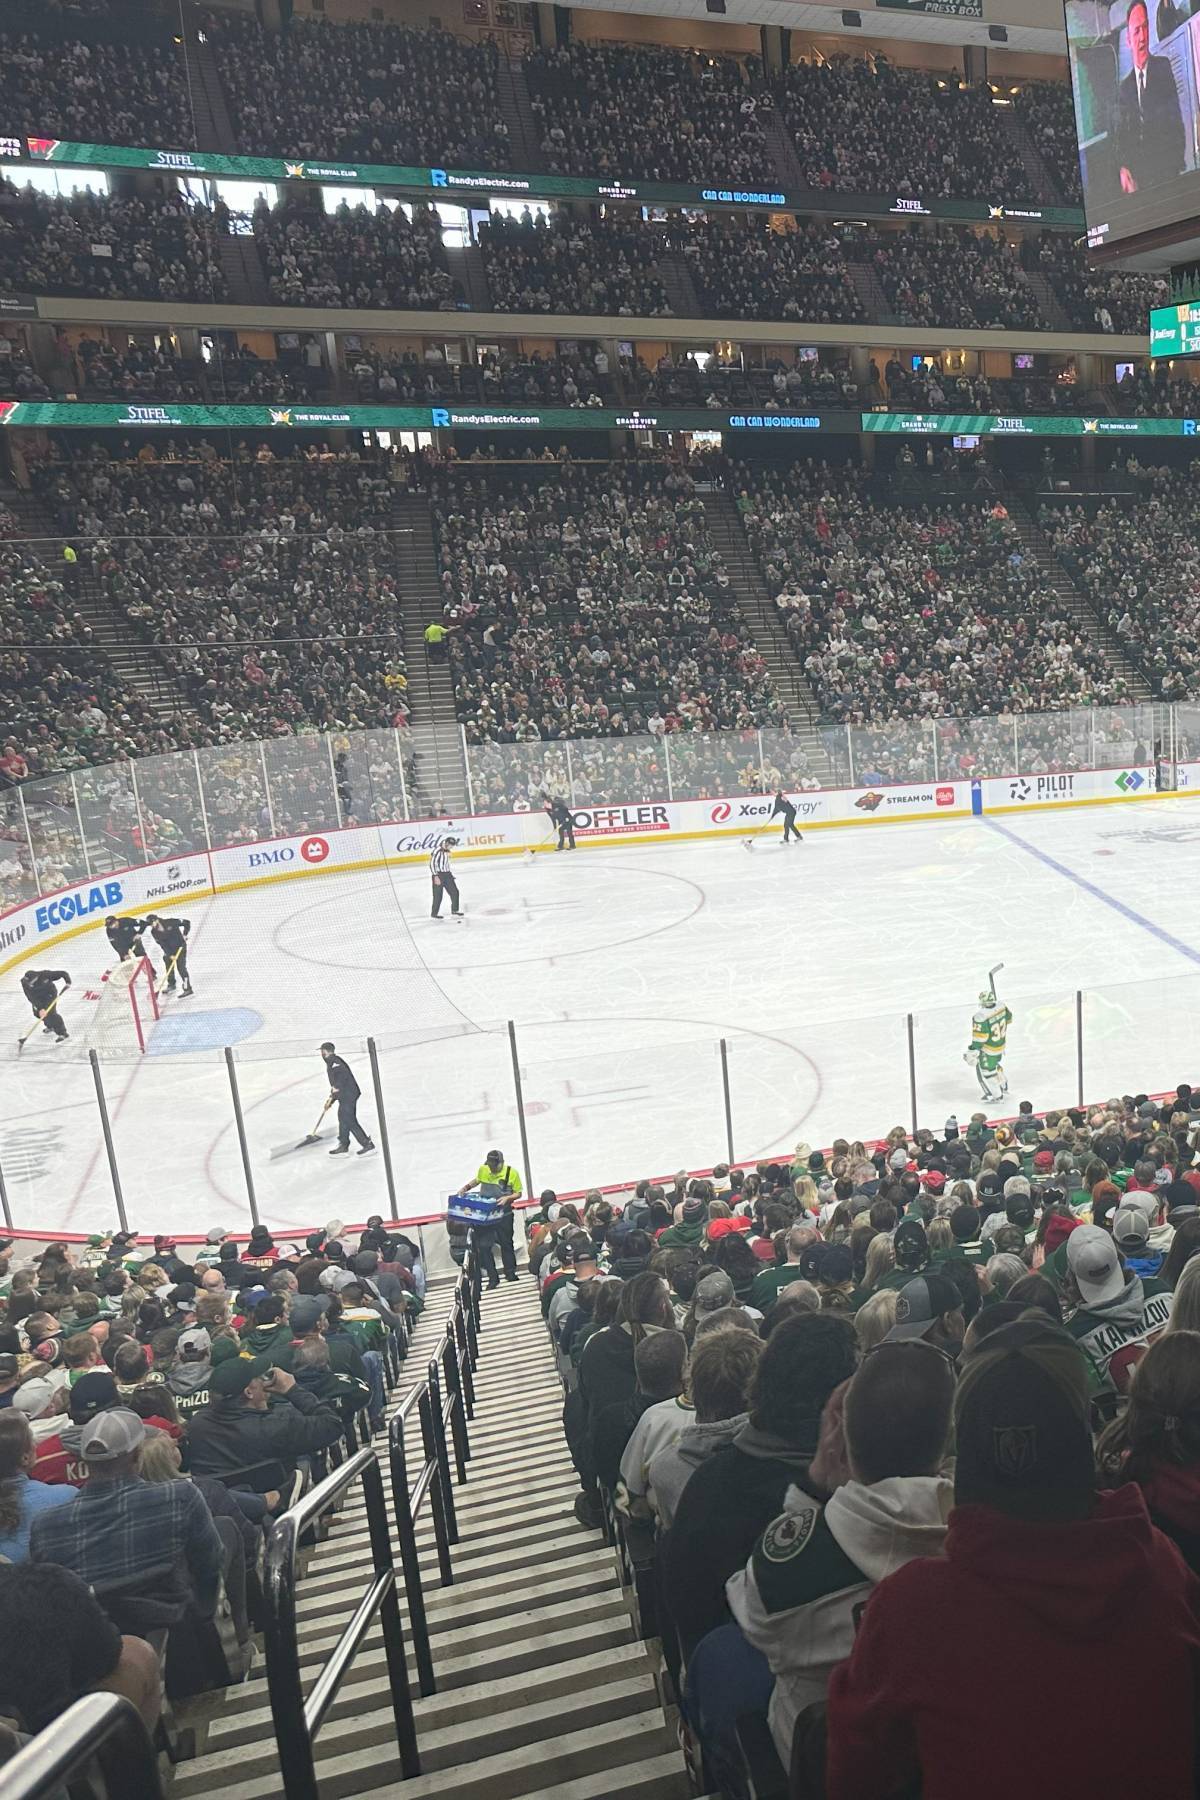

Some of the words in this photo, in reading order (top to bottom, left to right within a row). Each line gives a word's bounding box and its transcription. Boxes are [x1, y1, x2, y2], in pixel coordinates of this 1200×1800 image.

[924, 2, 957, 14] PRESS
[958, 6, 982, 17] BOX
[157, 151, 195, 166] STIFEL
[448, 175, 529, 189] RandysElectric.com
[702, 190, 717, 200] CAN
[718, 191, 732, 201] CAN
[733, 192, 785, 204] WONDERLAND
[896, 198, 923, 209] STIFEL
[128, 406, 169, 419] STIFEL
[451, 414, 539, 425] RandysElectric.com
[729, 416, 745, 427] CAN
[746, 416, 763, 427] CAN
[764, 417, 820, 428] WONDERLAND
[997, 417, 1025, 428] STIFEL
[1037, 775, 1074, 793] PILOT
[887, 795, 919, 805] STREAM
[921, 794, 933, 802] ON
[572, 806, 669, 829] OFFLER
[467, 834, 506, 847] LIGHT
[248, 847, 294, 867] BMO
[146, 878, 207, 899] NHLSHOP.com
[35, 881, 124, 932] ECOLAB
[174, 1389, 209, 1408] PRIZO
